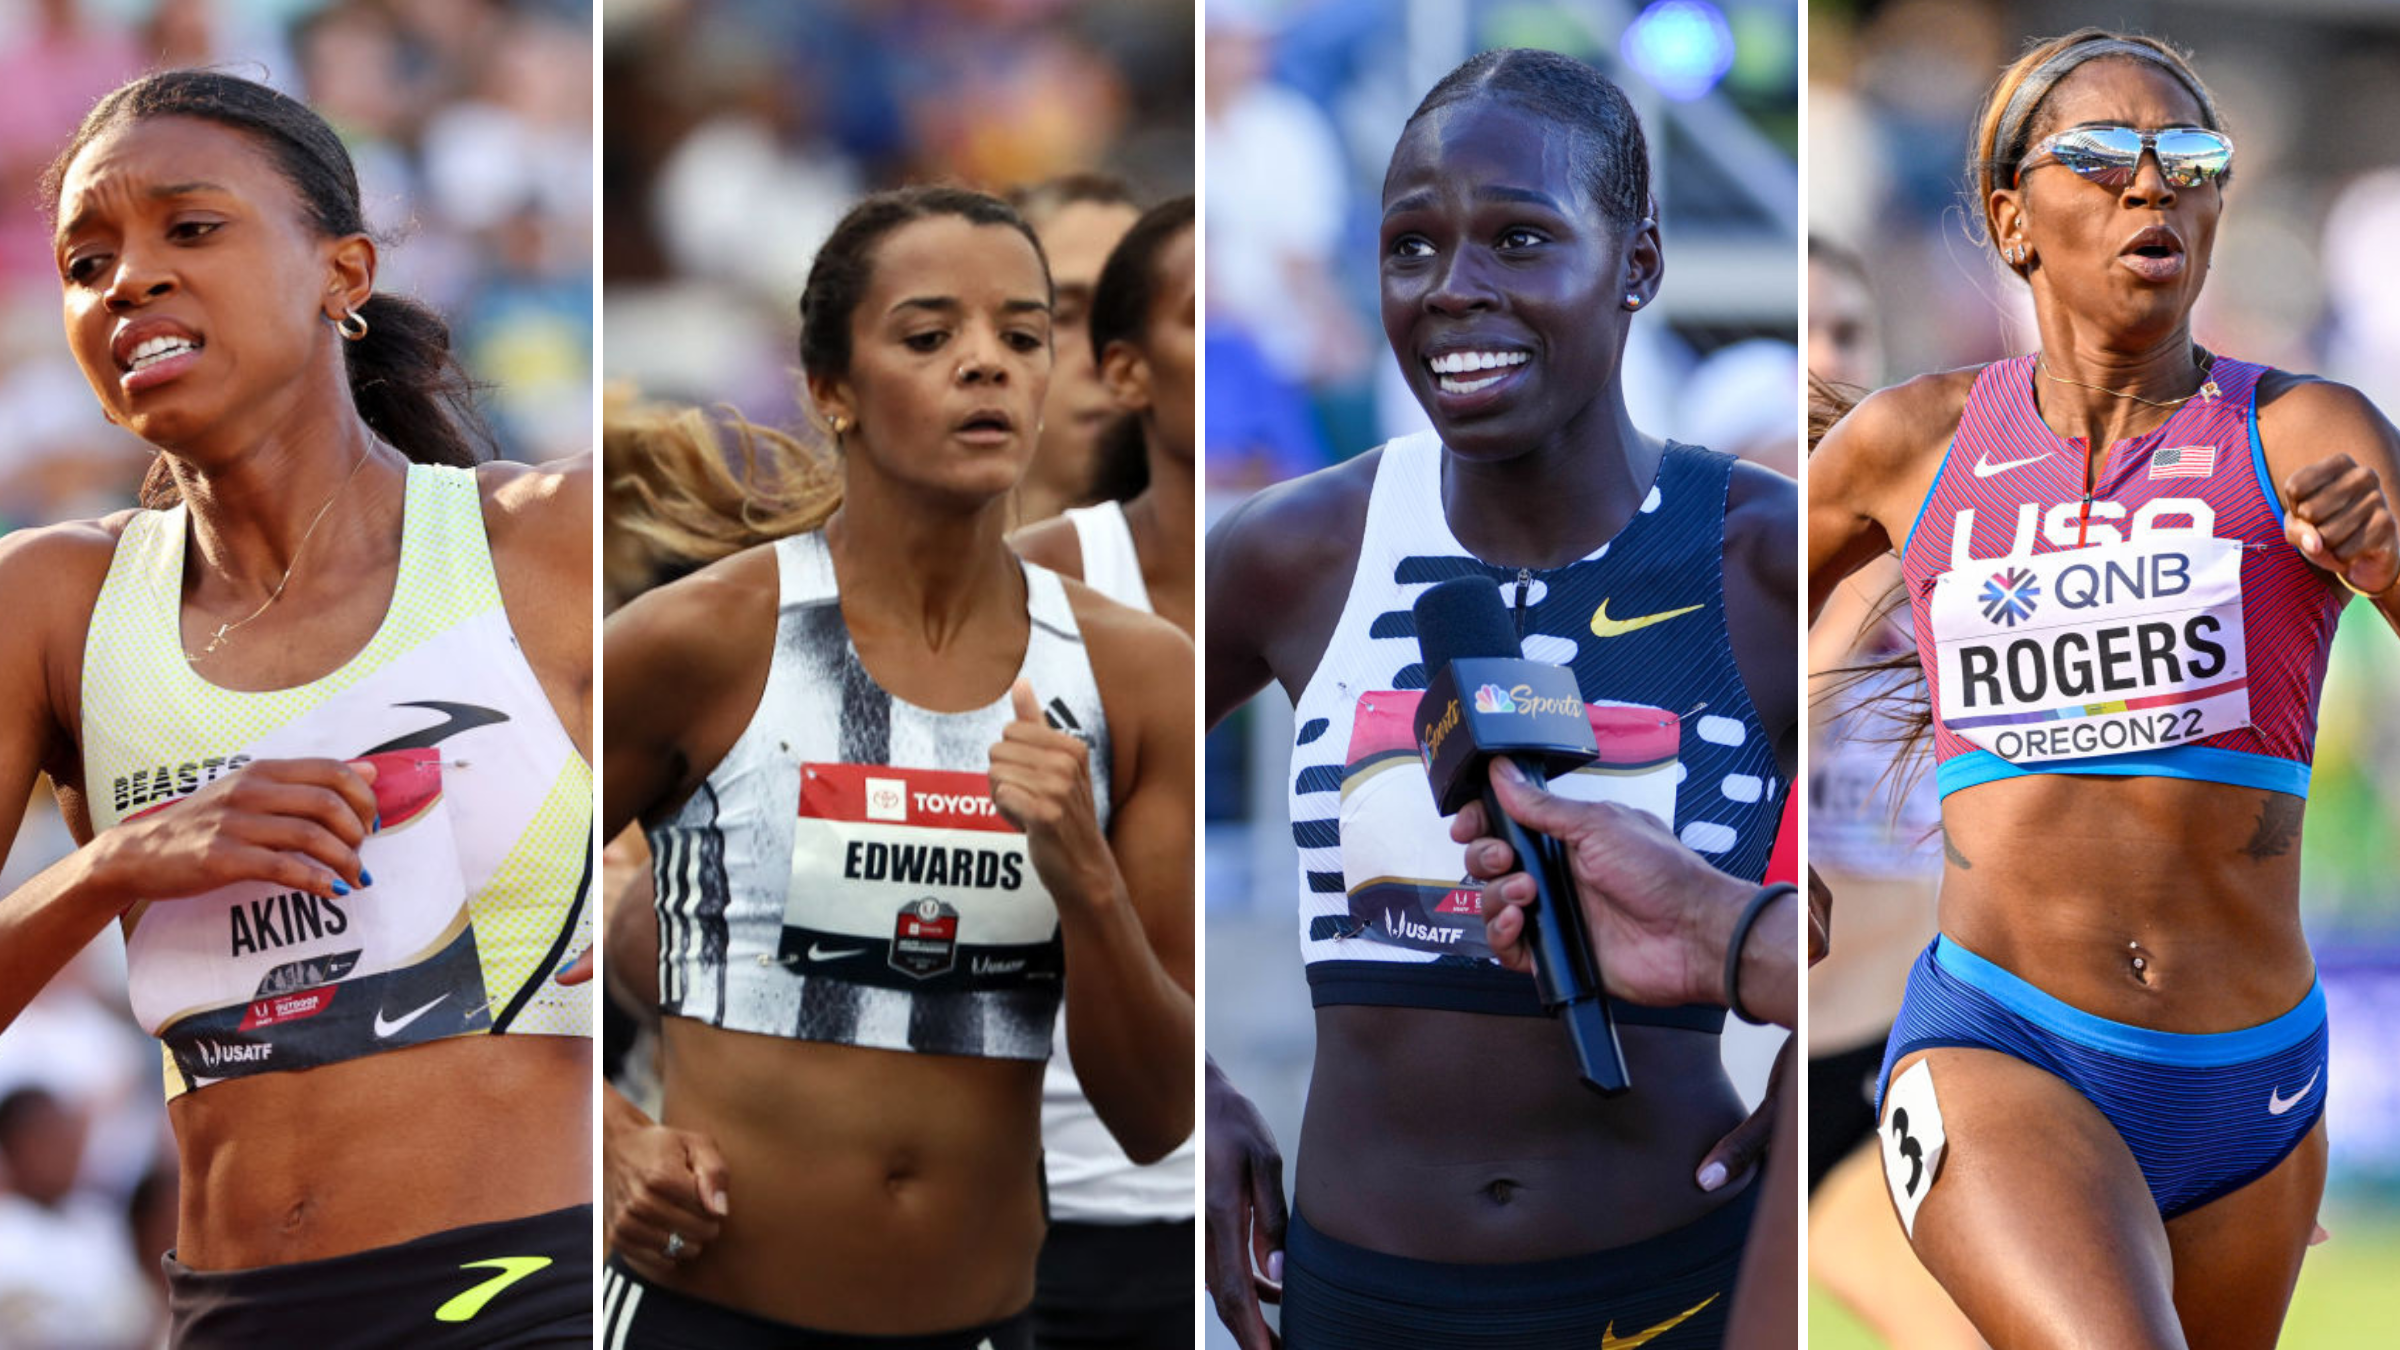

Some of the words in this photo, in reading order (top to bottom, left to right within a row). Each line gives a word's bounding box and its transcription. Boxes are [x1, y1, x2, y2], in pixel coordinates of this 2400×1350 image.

[2054, 552, 2192, 611] QNB
[1959, 614, 2227, 708] ROGERS
[1510, 683, 1582, 719] Sports
[1425, 698, 1460, 761] Sports
[1995, 707, 2205, 760] OREGON22
[844, 840, 1023, 891] EDWARDS
[230, 893, 347, 957] AKINS
[1405, 922, 1463, 943] USATF
[223, 1043, 273, 1062] USATF
[1892, 1106, 1923, 1199] 3
